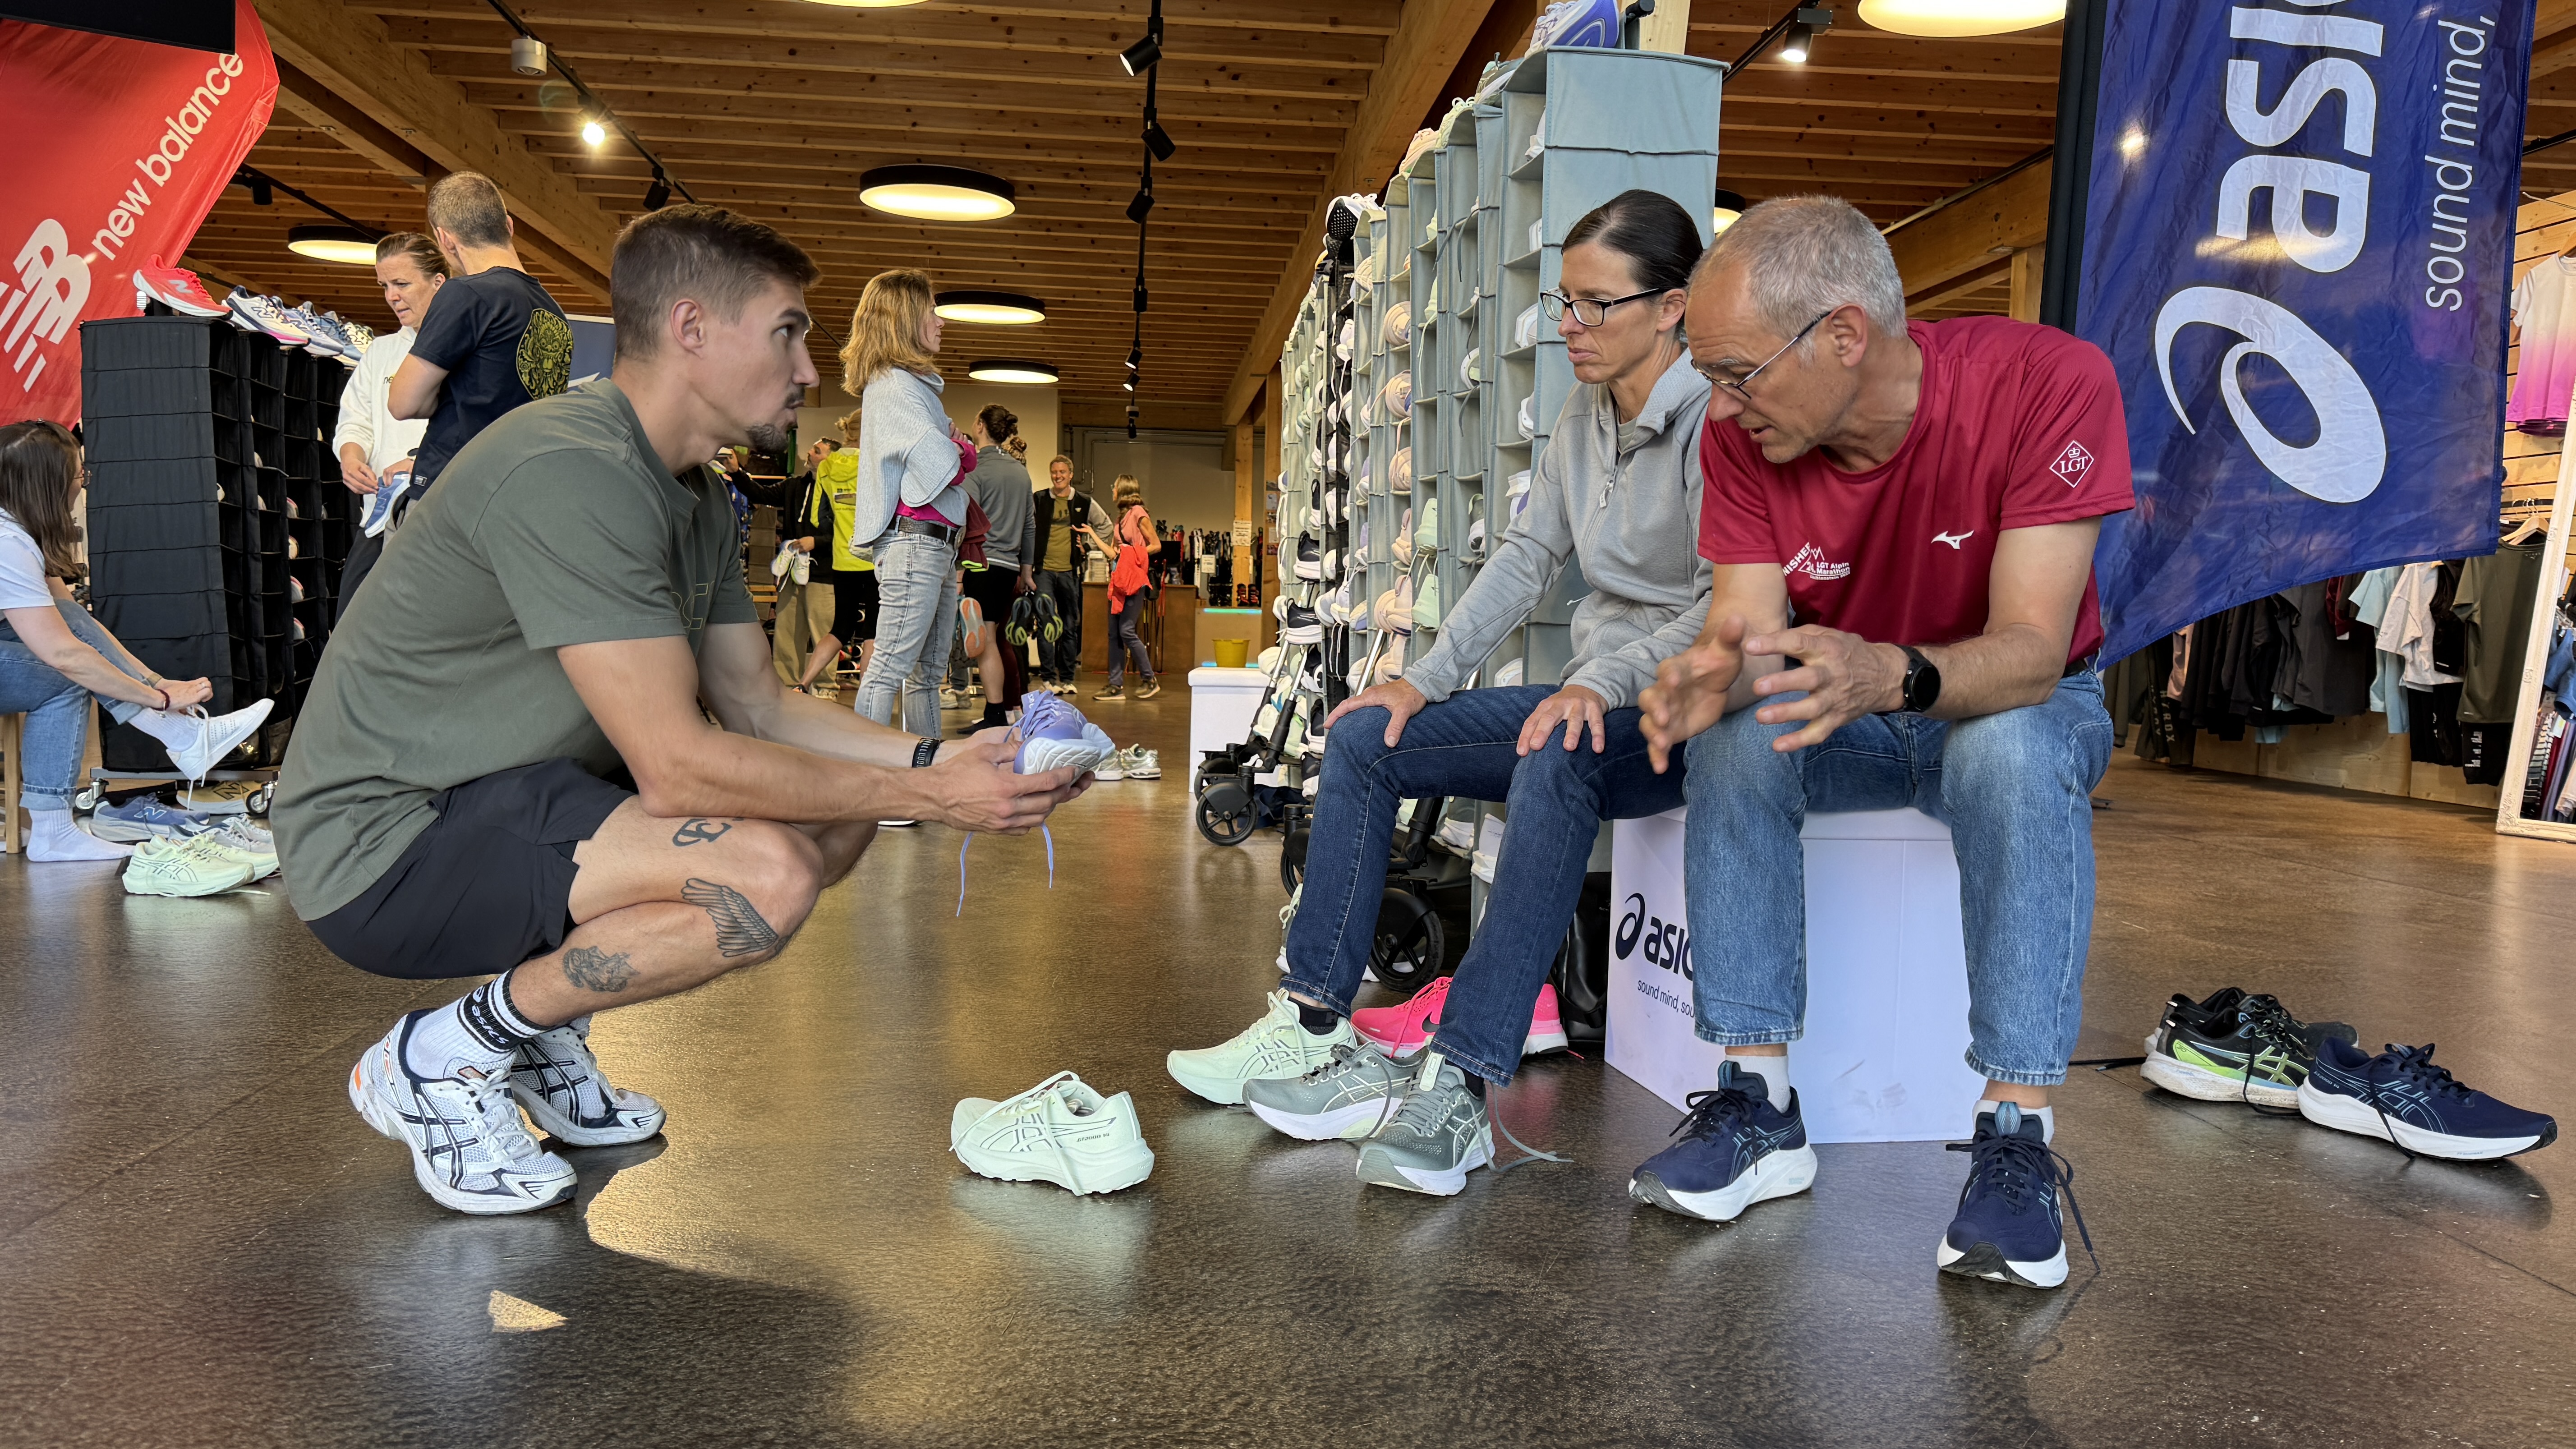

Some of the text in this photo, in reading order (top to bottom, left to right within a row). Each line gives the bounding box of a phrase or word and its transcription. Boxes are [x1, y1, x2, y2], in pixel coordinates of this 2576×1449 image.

[91, 53, 244, 261] new balance
[2216, 0, 2384, 272] asi
[2425, 15, 2496, 312] sound mind,
[2059, 456, 2088, 474] LGT
[1638, 980, 1660, 999] sound
[1660, 990, 1679, 1013] mind,
